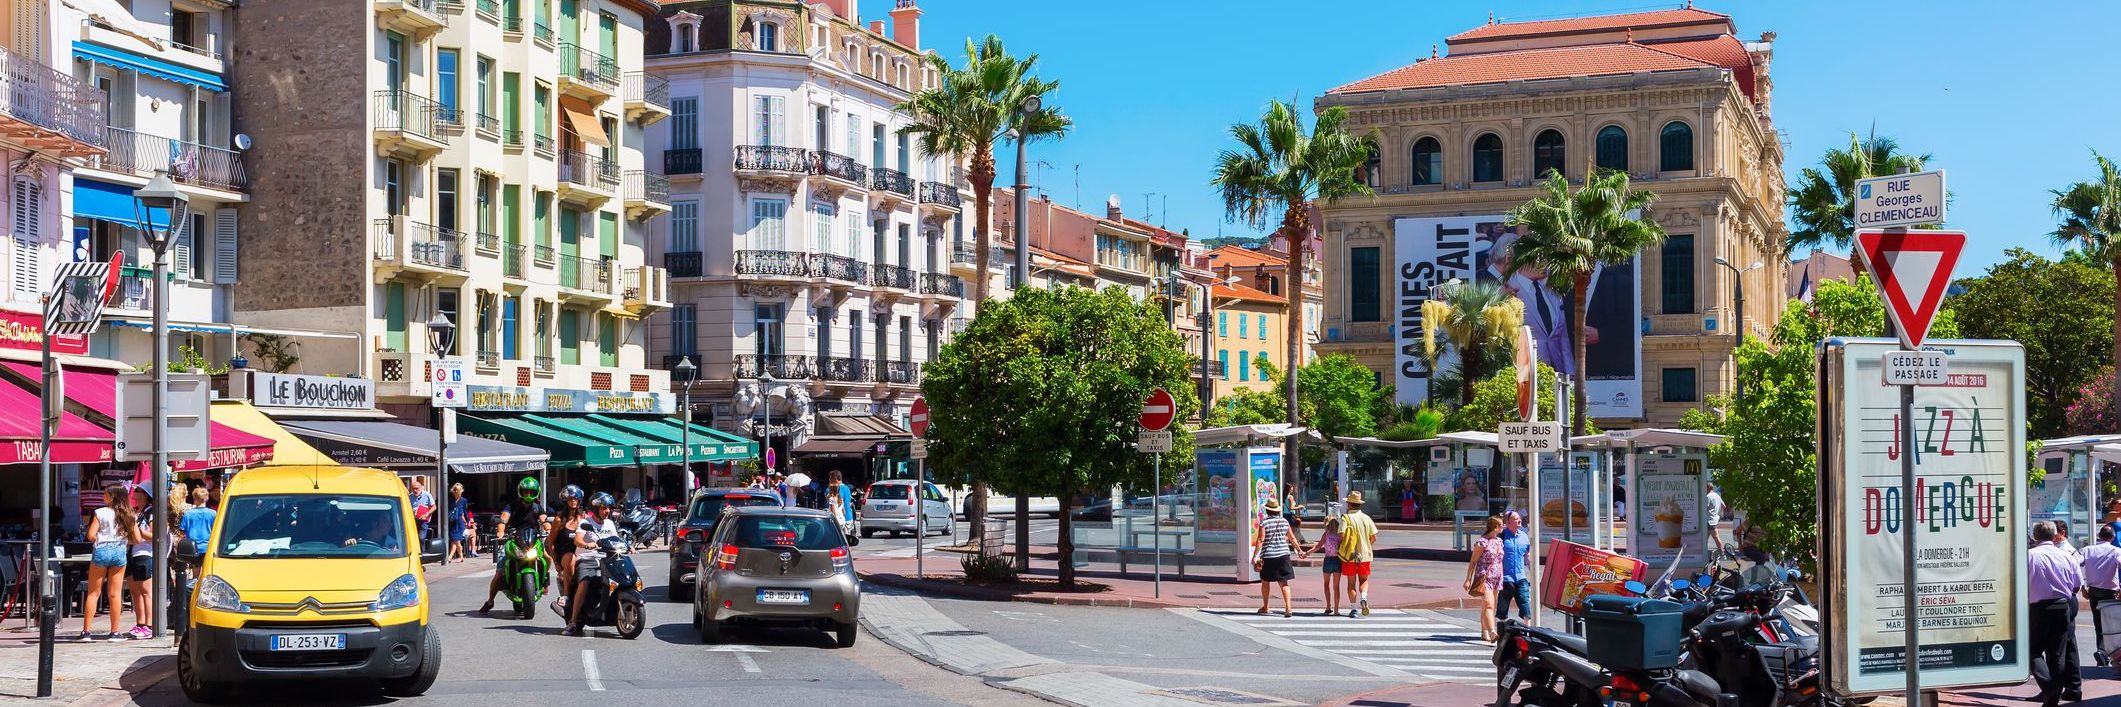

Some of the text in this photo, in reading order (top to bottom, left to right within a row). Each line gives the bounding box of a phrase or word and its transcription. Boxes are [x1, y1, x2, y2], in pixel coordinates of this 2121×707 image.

[1887, 180, 1910, 193] RUE
[1876, 194, 1922, 207] Georges
[1859, 206, 1938, 224] CLEMENCEAU
[1893, 355, 1941, 367] CÉDEZ LE
[1895, 369, 1938, 379] PASSAGE
[1970, 375, 1984, 386] 2016
[271, 376, 367, 403] LE BOUCHON
[472, 392, 655, 411] RESTAURANT PIZZA RESTAURANT
[1505, 425, 1551, 435] SAUF BUS
[1969, 396, 1986, 453] À
[1508, 440, 1548, 448] ET TAXIS
[208, 449, 246, 467] RESTAURANT
[350, 449, 362, 457] 2,60
[609, 447, 624, 459] PIZZA
[634, 446, 660, 458] RESTAURANT
[668, 446, 676, 457] LA
[676, 446, 693, 456] PIAZA
[1924, 548, 1954, 560] DOMERGUE
[1959, 547, 1970, 559] 21H
[1950, 584, 1972, 592] KAROL
[1974, 583, 1994, 591] BEFFA
[1921, 596, 1937, 606] ÉRIC
[1926, 606, 1966, 615] COULONDRE
[1922, 619, 1951, 627] BARNES
[1960, 617, 1988, 625] EQUINOX
[279, 636, 337, 649] DL-253-VZ
